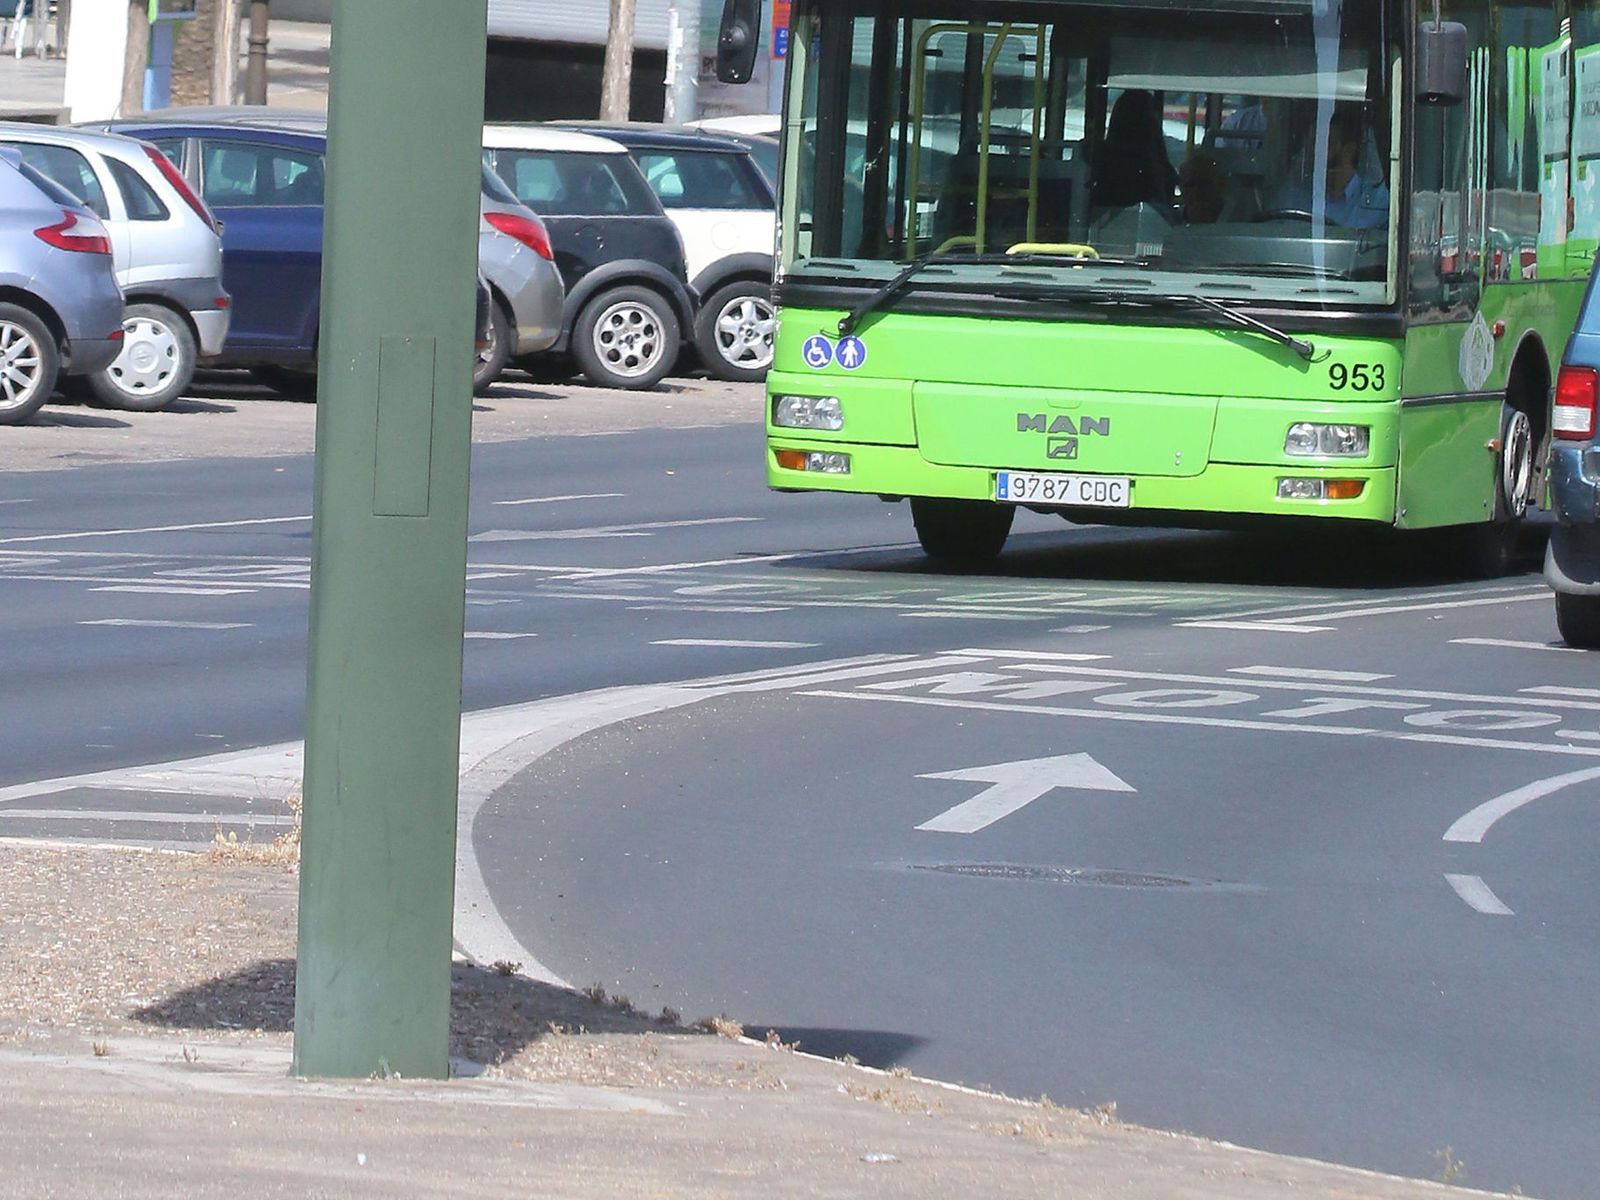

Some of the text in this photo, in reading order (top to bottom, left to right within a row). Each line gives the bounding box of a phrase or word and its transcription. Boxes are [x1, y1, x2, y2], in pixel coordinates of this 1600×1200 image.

[1328, 362, 1385, 392] 953
[1016, 412, 1110, 436] MAN
[1013, 477, 1070, 500] 9787
[1080, 480, 1121, 502] CDC
[855, 672, 1600, 741] MOTO
